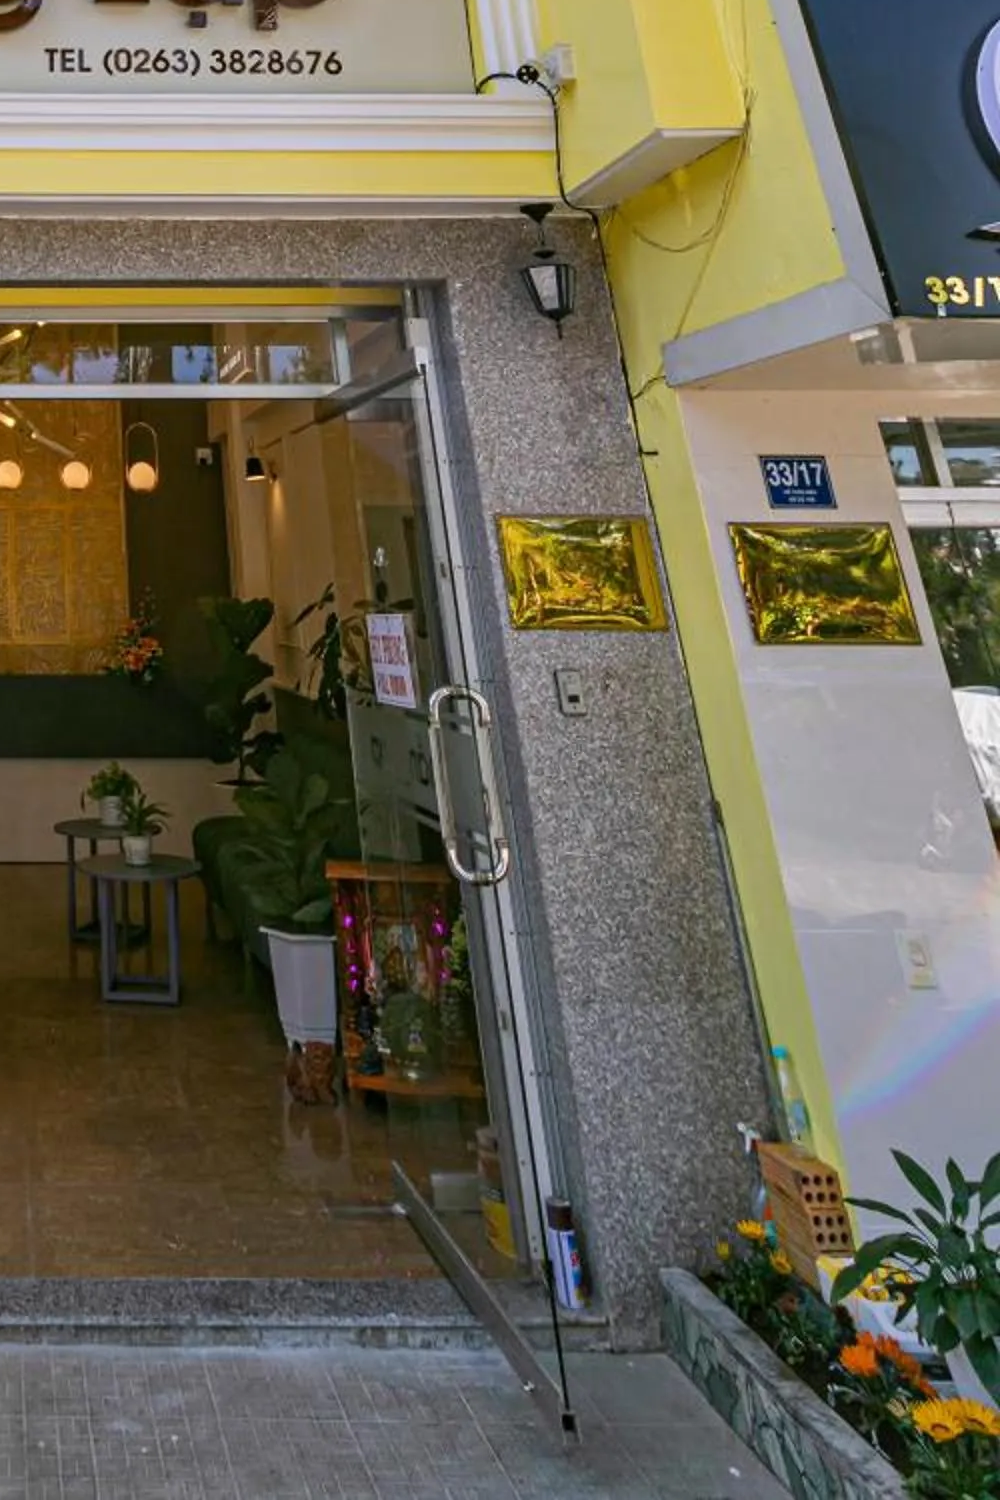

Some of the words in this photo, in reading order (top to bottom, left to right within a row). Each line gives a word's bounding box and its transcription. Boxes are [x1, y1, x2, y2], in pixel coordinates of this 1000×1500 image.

[45, 48, 92, 74] TEL
[103, 48, 201, 77] (0263)
[209, 49, 343, 75] 3828676
[766, 461, 822, 487] 33/17
